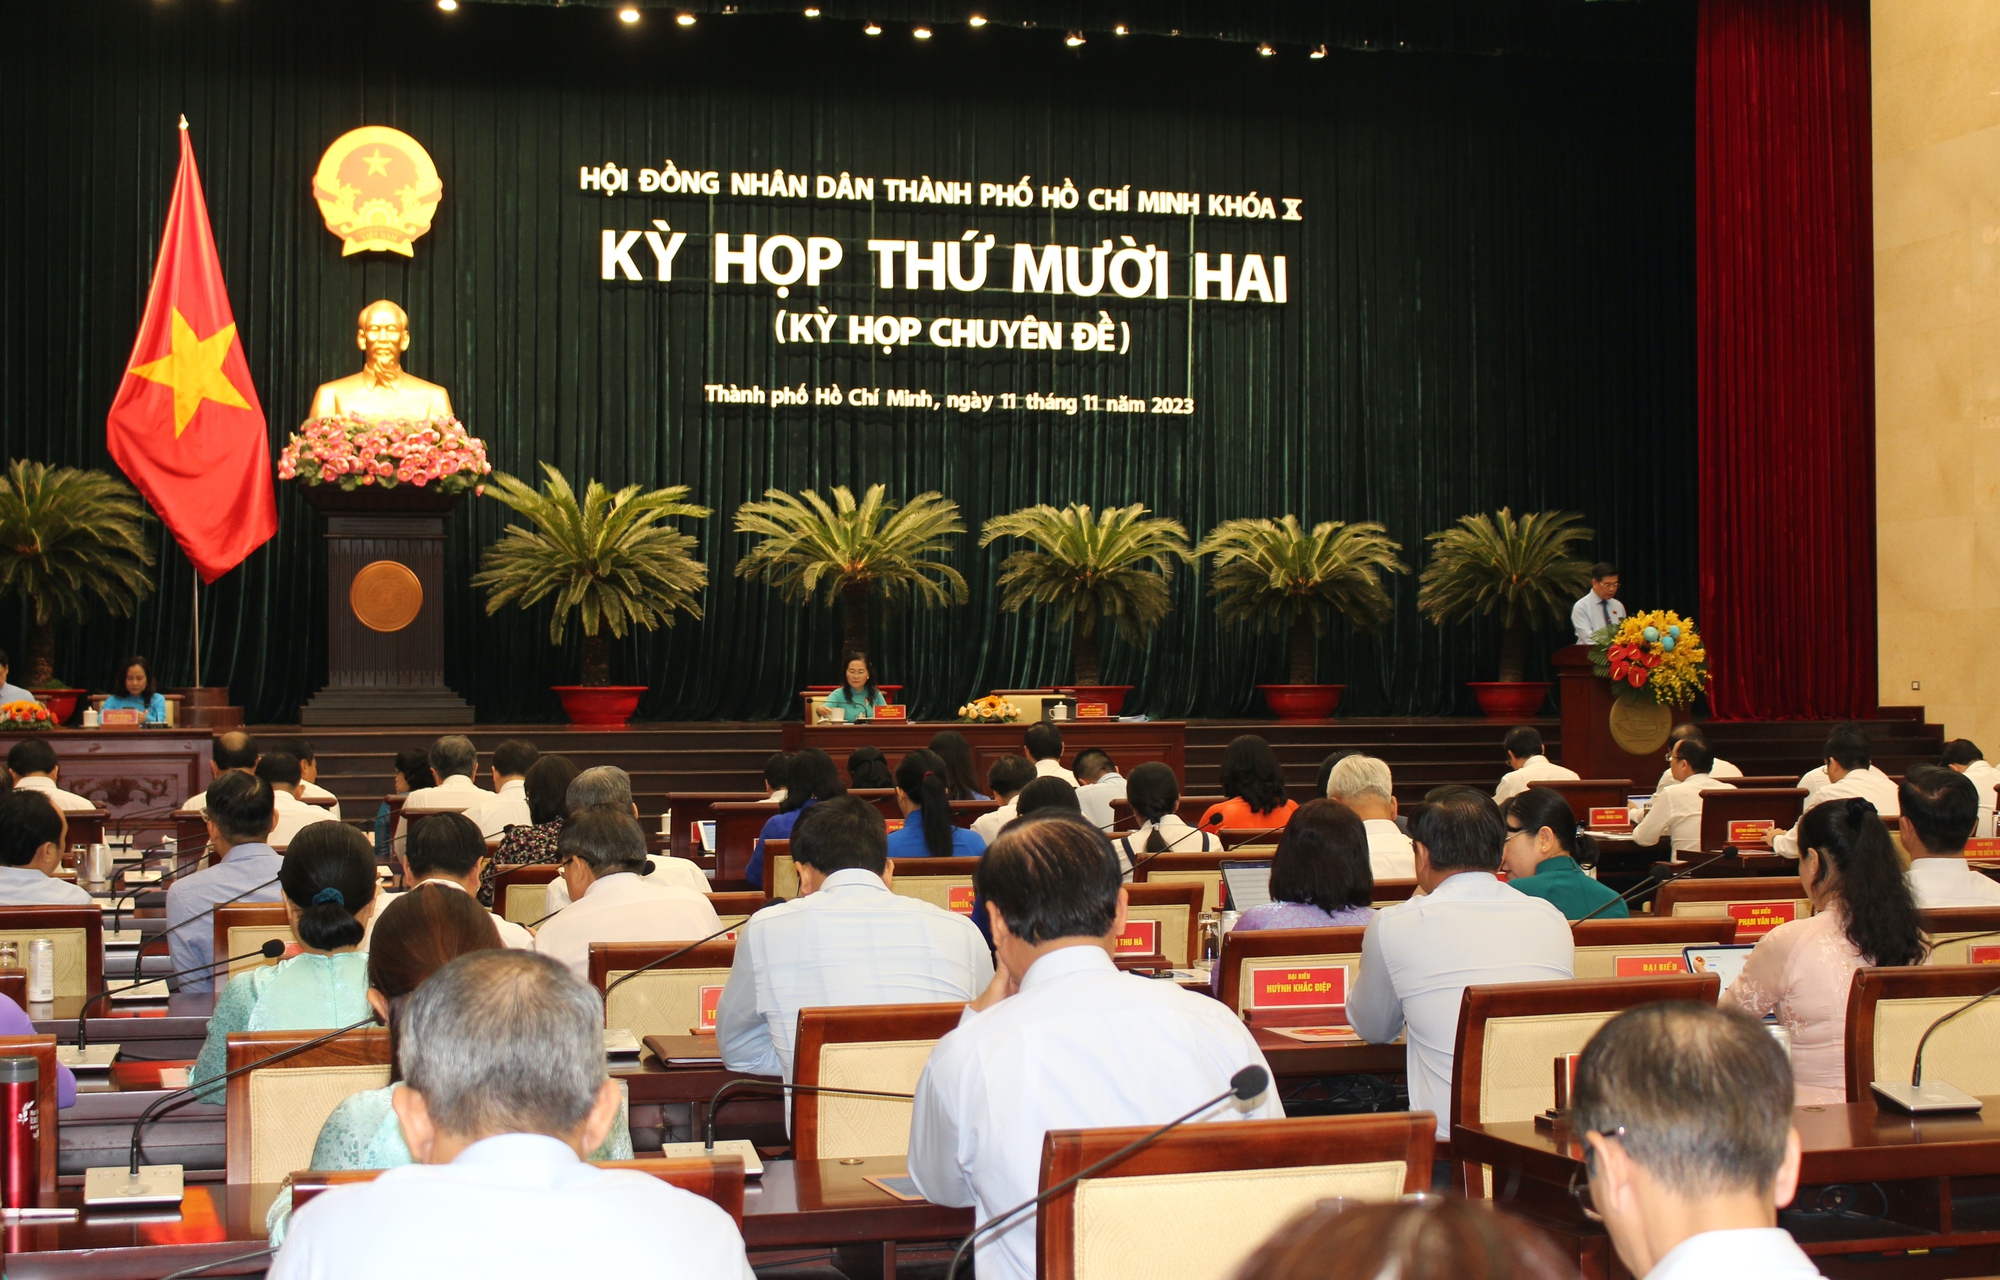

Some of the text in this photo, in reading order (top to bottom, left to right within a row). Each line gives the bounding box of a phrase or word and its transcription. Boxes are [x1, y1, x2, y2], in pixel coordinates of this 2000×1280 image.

[581, 159, 1302, 221] HỘI ĐỒNG NHÂN DÂN THÀNH PHỐ HỒ CHÍ MINH KHÓA X
[602, 219, 1287, 303] KỲ HỌP THỨ MƯỜI HAI
[775, 306, 1130, 355] (KỲ HỌP CHUYÊN ĐỀ)
[704, 383, 1195, 415] Thành phố Hồ Chí Minh, ngày 11 tháng 11 năm 2023
[1738, 917, 1756, 928] PHẠM
[1119, 938, 1133, 946] THU
[1133, 936, 1143, 946] HÀ
[1642, 961, 1678, 973] ĐẠI BIỂU
[1266, 982, 1292, 994] HUỲNH
[1293, 981, 1313, 993] KHẮC
